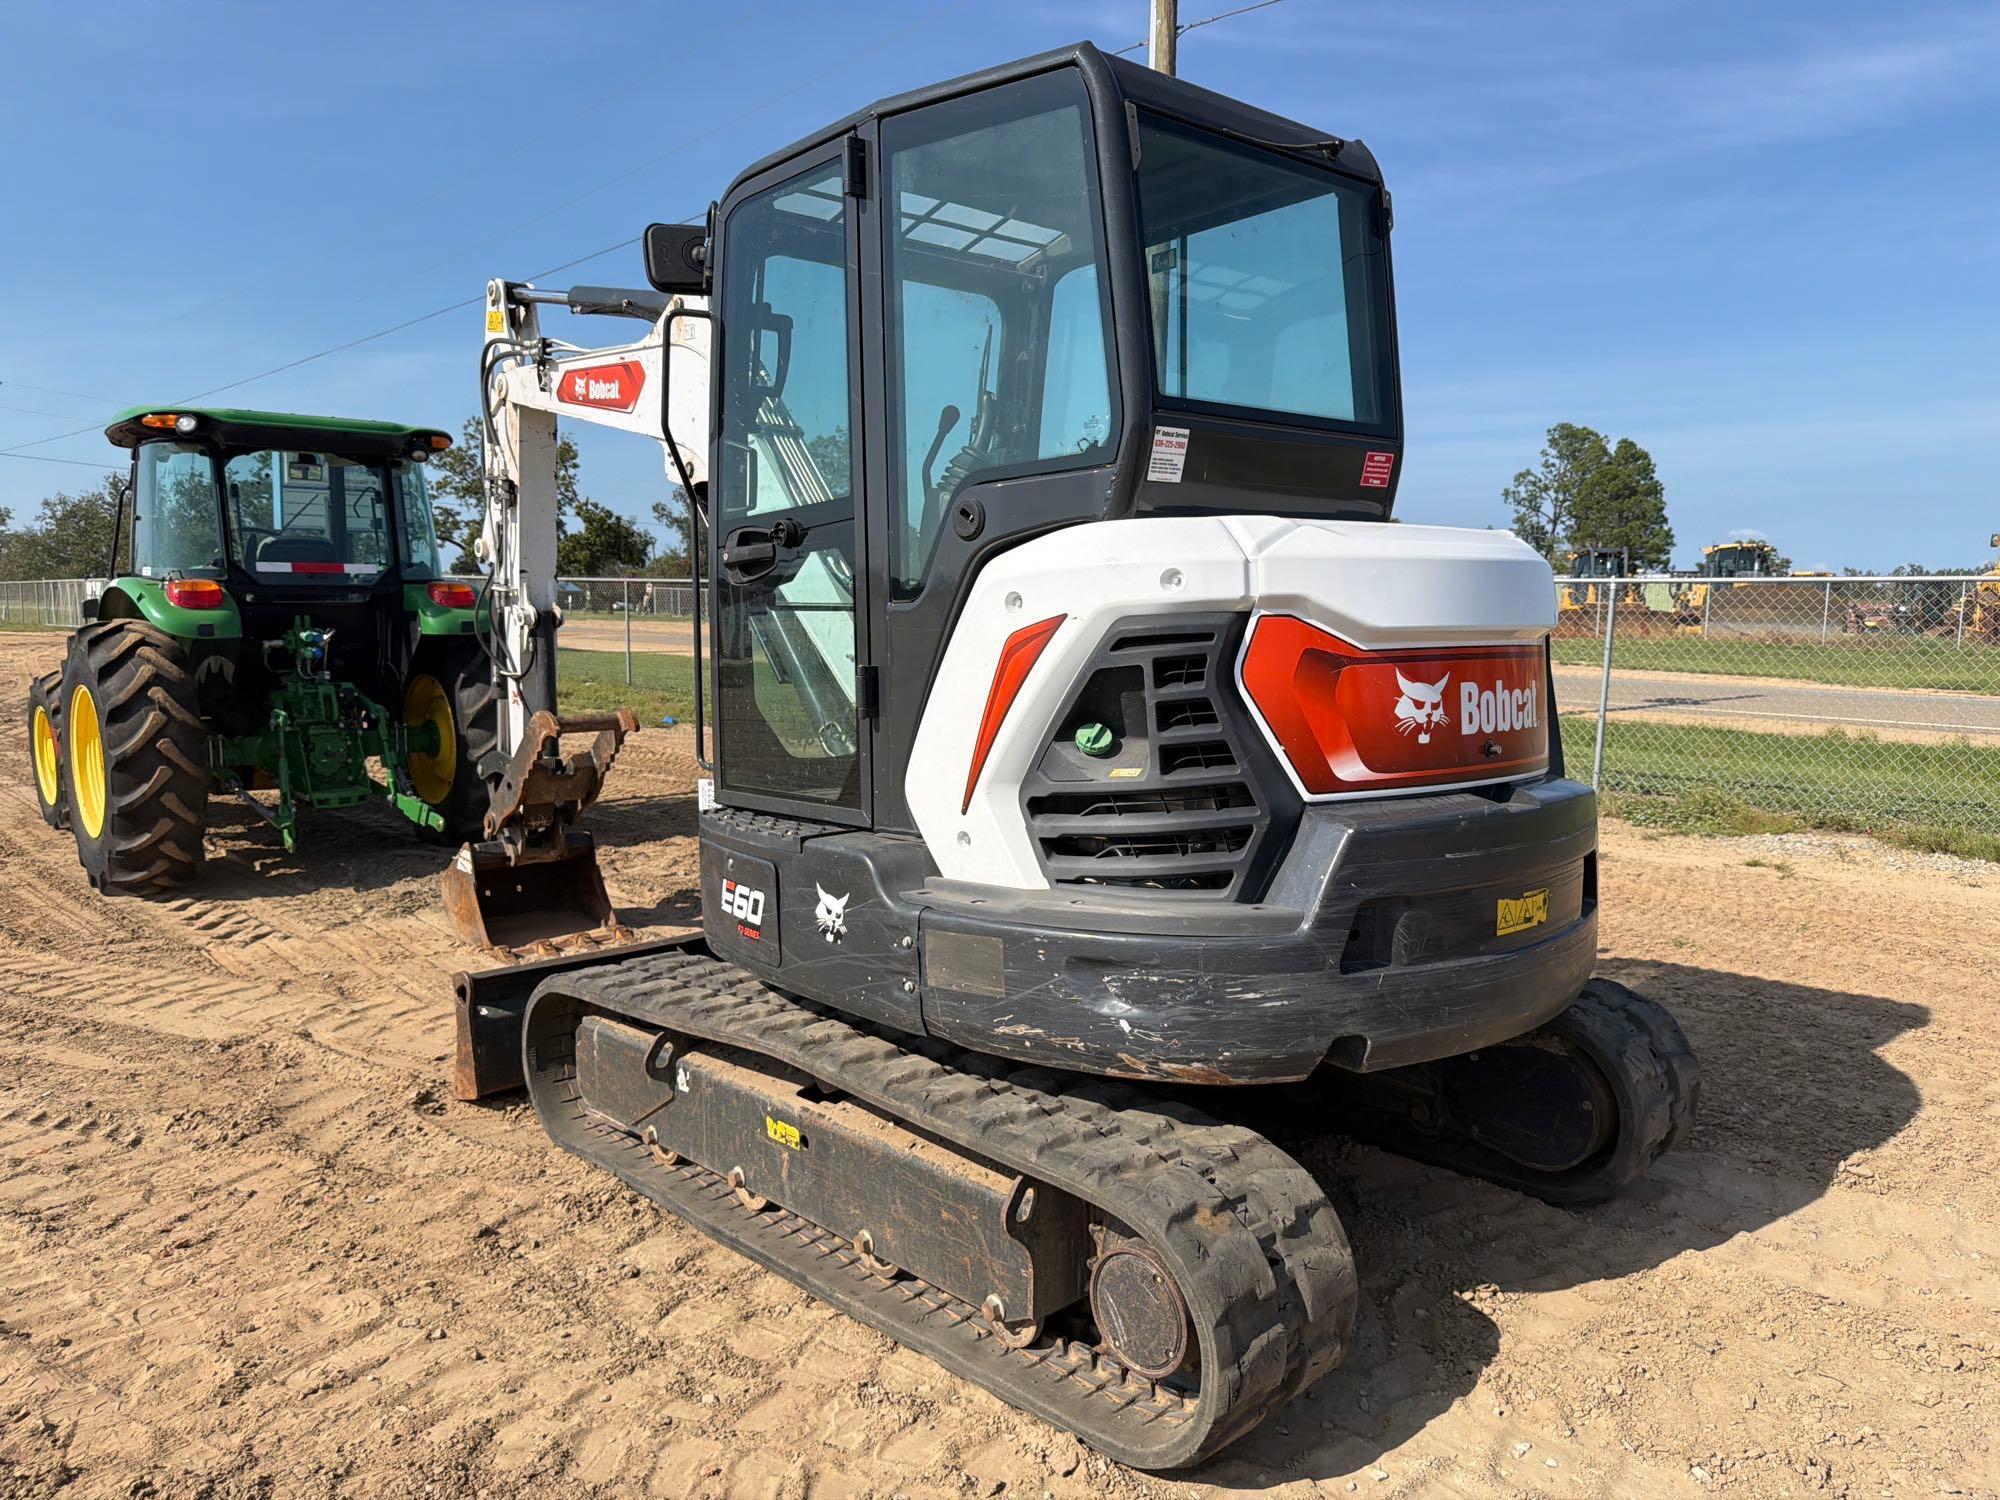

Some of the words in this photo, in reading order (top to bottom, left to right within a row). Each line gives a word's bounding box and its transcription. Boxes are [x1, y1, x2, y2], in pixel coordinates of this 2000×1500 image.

[589, 379, 619, 400] Bobcat
[1460, 680, 1538, 735] Bobcat
[721, 878, 765, 926] E60
